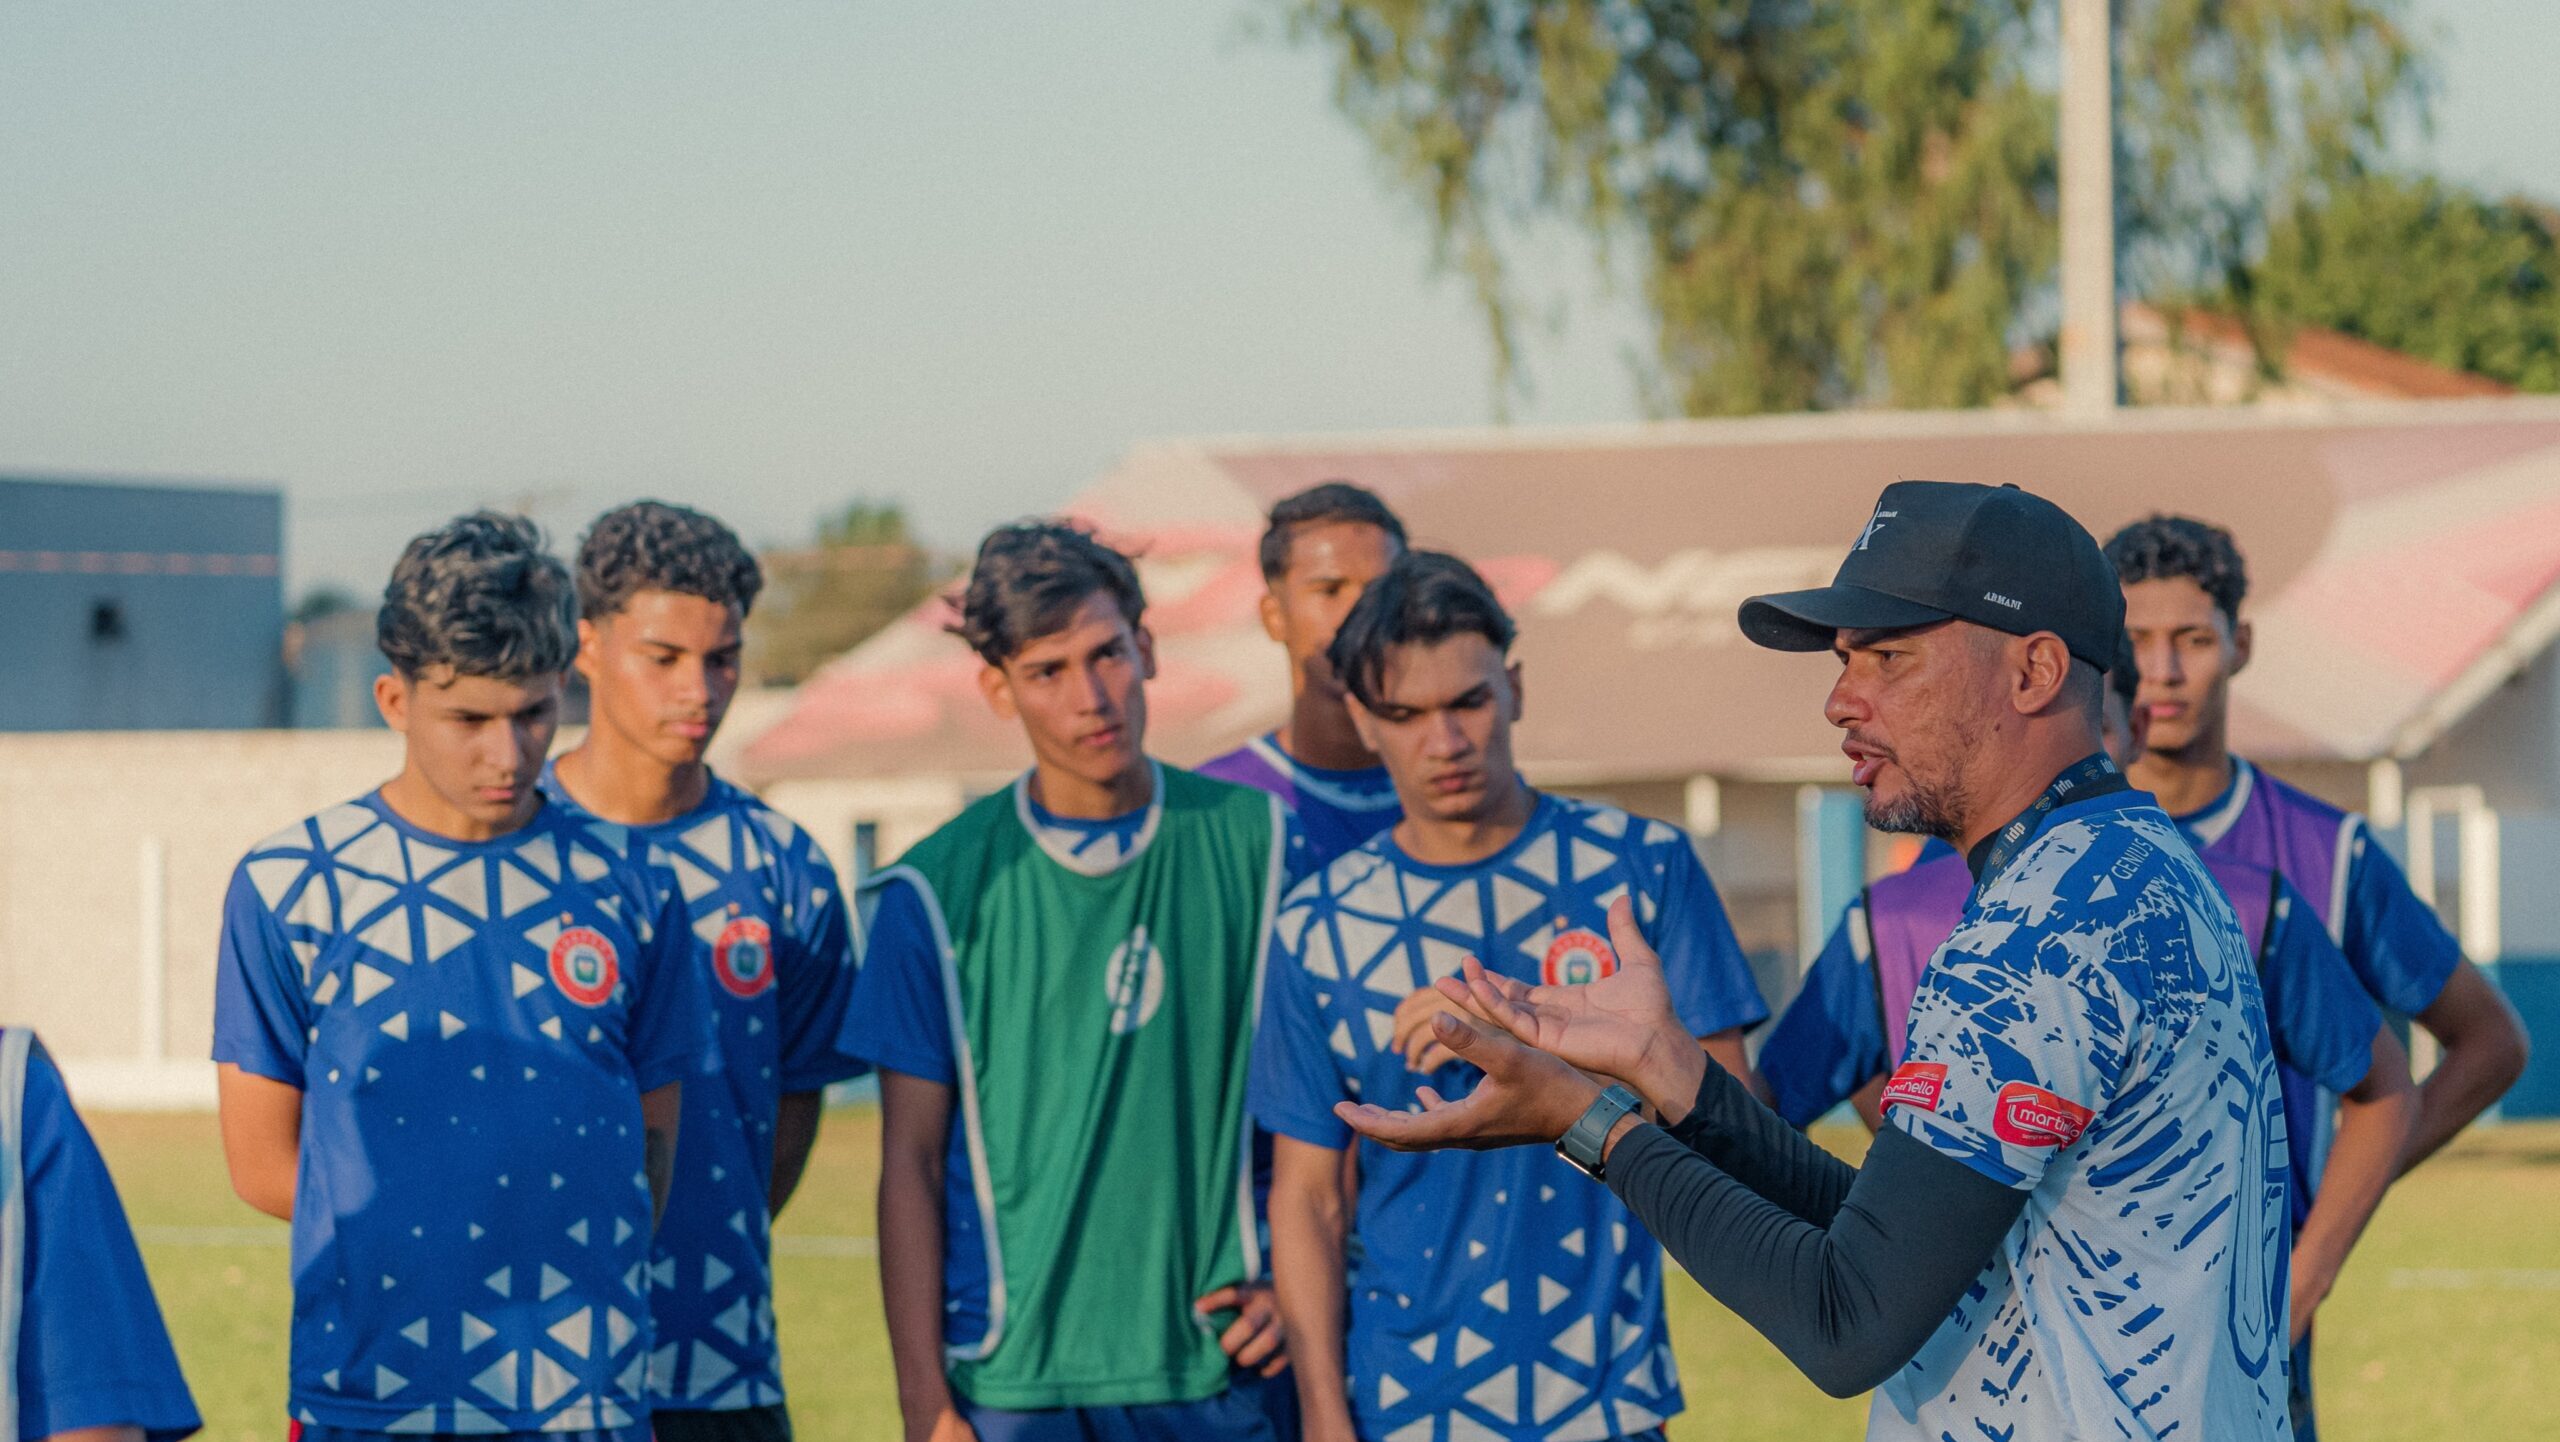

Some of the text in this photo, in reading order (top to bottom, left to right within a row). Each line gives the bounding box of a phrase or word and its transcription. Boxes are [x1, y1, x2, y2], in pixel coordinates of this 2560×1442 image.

[1983, 591, 2022, 610] ARMANI
[2004, 822, 2026, 843] idp
[2111, 837, 2154, 880] GENIUS
